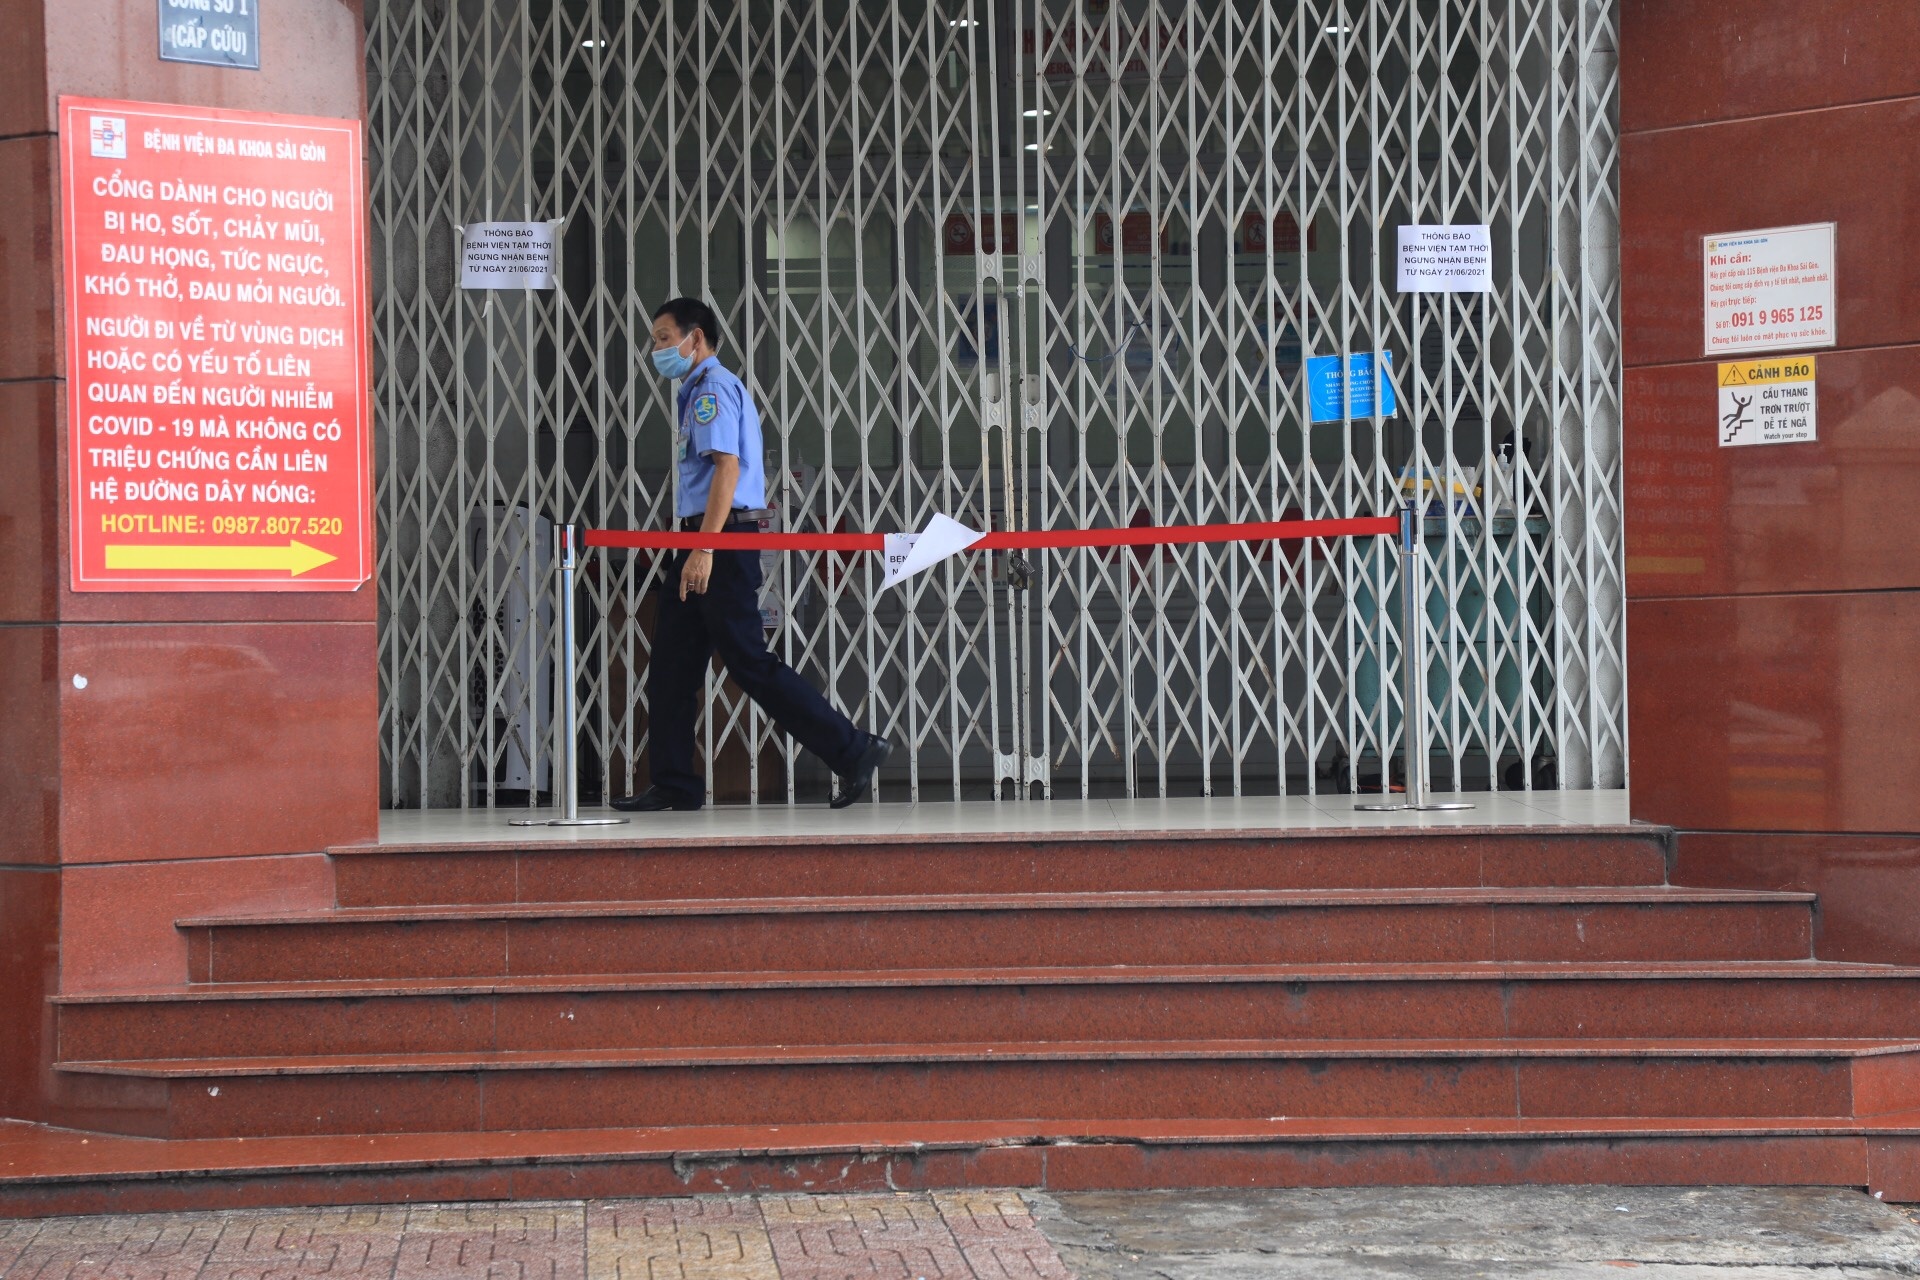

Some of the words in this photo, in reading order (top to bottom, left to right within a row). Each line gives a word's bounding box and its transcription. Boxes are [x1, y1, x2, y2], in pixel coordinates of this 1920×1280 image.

[171, 18, 207, 48] (CẤP
[211, 24, 247, 56] CỨU)
[144, 128, 180, 152] BỆNH
[184, 132, 214, 156] VIỆN
[218, 138, 235, 154] ĐA
[239, 140, 272, 157] KHOA
[276, 139, 296, 159] SÀI
[300, 143, 325, 161] GÒN
[93, 169, 153, 199] CỔNG
[160, 178, 216, 203] DÀNH
[224, 186, 266, 206] CHO
[271, 185, 333, 212] NGƯỜI
[105, 211, 124, 234] BỊ
[131, 213, 166, 236] HO,
[172, 210, 217, 239] SỐT,
[224, 214, 278, 239] CHẢY
[285, 220, 324, 244] MŨI,
[484, 228, 513, 237] THÔNG
[516, 228, 533, 237] BÁO
[1422, 232, 1450, 240] THÔNG
[1452, 232, 1471, 240] BÁO
[466, 241, 488, 250] BỆNH
[491, 241, 510, 250] VIỆN
[512, 242, 529, 250] TẠM
[532, 241, 551, 249] THỜI
[1402, 244, 1426, 253] BỆNH
[1428, 244, 1446, 253] VIỆN
[1449, 245, 1466, 253] TẠM
[1469, 244, 1488, 252] THỜI
[101, 244, 144, 264] ĐAU
[151, 247, 215, 271] HỌNG,
[221, 247, 260, 270] TỨC
[268, 254, 328, 277] NGỰC,
[468, 253, 499, 261] NGƯNG
[501, 253, 524, 262] NHẬN
[526, 252, 549, 262] BỆNH
[1438, 256, 1461, 266] NHẬN
[1464, 256, 1486, 266] BỆNH
[1710, 254, 1726, 266] Khi
[1730, 252, 1752, 264] cần:
[469, 264, 481, 272] TỪ
[482, 264, 506, 272] NGÀY
[1405, 268, 1417, 276] TỪ
[1420, 268, 1442, 276] NGÀY
[85, 272, 130, 296] KHÓ
[135, 273, 183, 302] THỞ,
[189, 281, 230, 301] ĐAU
[237, 282, 273, 303] MỎI
[279, 284, 345, 306] NGƯỜI.
[1732, 312, 1754, 327] 091
[1760, 310, 1766, 324] 9
[1771, 308, 1794, 324] 965
[1800, 306, 1822, 322] 125
[87, 315, 149, 338] NGƯỜI
[155, 320, 173, 339] ĐI
[180, 315, 204, 340] VỀ
[210, 320, 236, 342] TỪ
[241, 321, 293, 344] VÙNG
[300, 328, 343, 348] DỊCH
[88, 347, 146, 373] HOẶC
[152, 349, 182, 372] CÓ
[188, 348, 228, 374] YẾU
[234, 350, 261, 375] TỐ
[267, 354, 310, 376] LIÊN
[1748, 364, 1780, 380] CẢNH
[1784, 363, 1809, 377] BÁO
[1325, 369, 1356, 379] THÔG
[88, 382, 146, 403] QUAN
[153, 379, 195, 404] ĐẾN
[202, 384, 265, 407] NGƯỜI
[272, 383, 333, 409] NHIỄM
[1781, 388, 1808, 398] THANG
[1760, 404, 1781, 414] TRƠN
[1784, 402, 1810, 414] TRƯỢT
[89, 415, 153, 436] COVID
[172, 419, 194, 437] 19
[200, 415, 230, 438] MÀ
[236, 416, 307, 440] KHÔNG
[313, 418, 341, 441] CÓ
[88, 444, 151, 471] TRIỆU
[157, 446, 230, 470] CHỨNG
[236, 445, 277, 470] CẦN
[284, 449, 327, 472] LIÊN
[90, 476, 118, 504] HỆ
[125, 478, 198, 501] ĐƯỜNG
[206, 479, 246, 502] DÂY
[252, 480, 315, 503] NÓNG:
[102, 514, 205, 534] HOTLINE:
[212, 515, 343, 536] 0987.807.520
